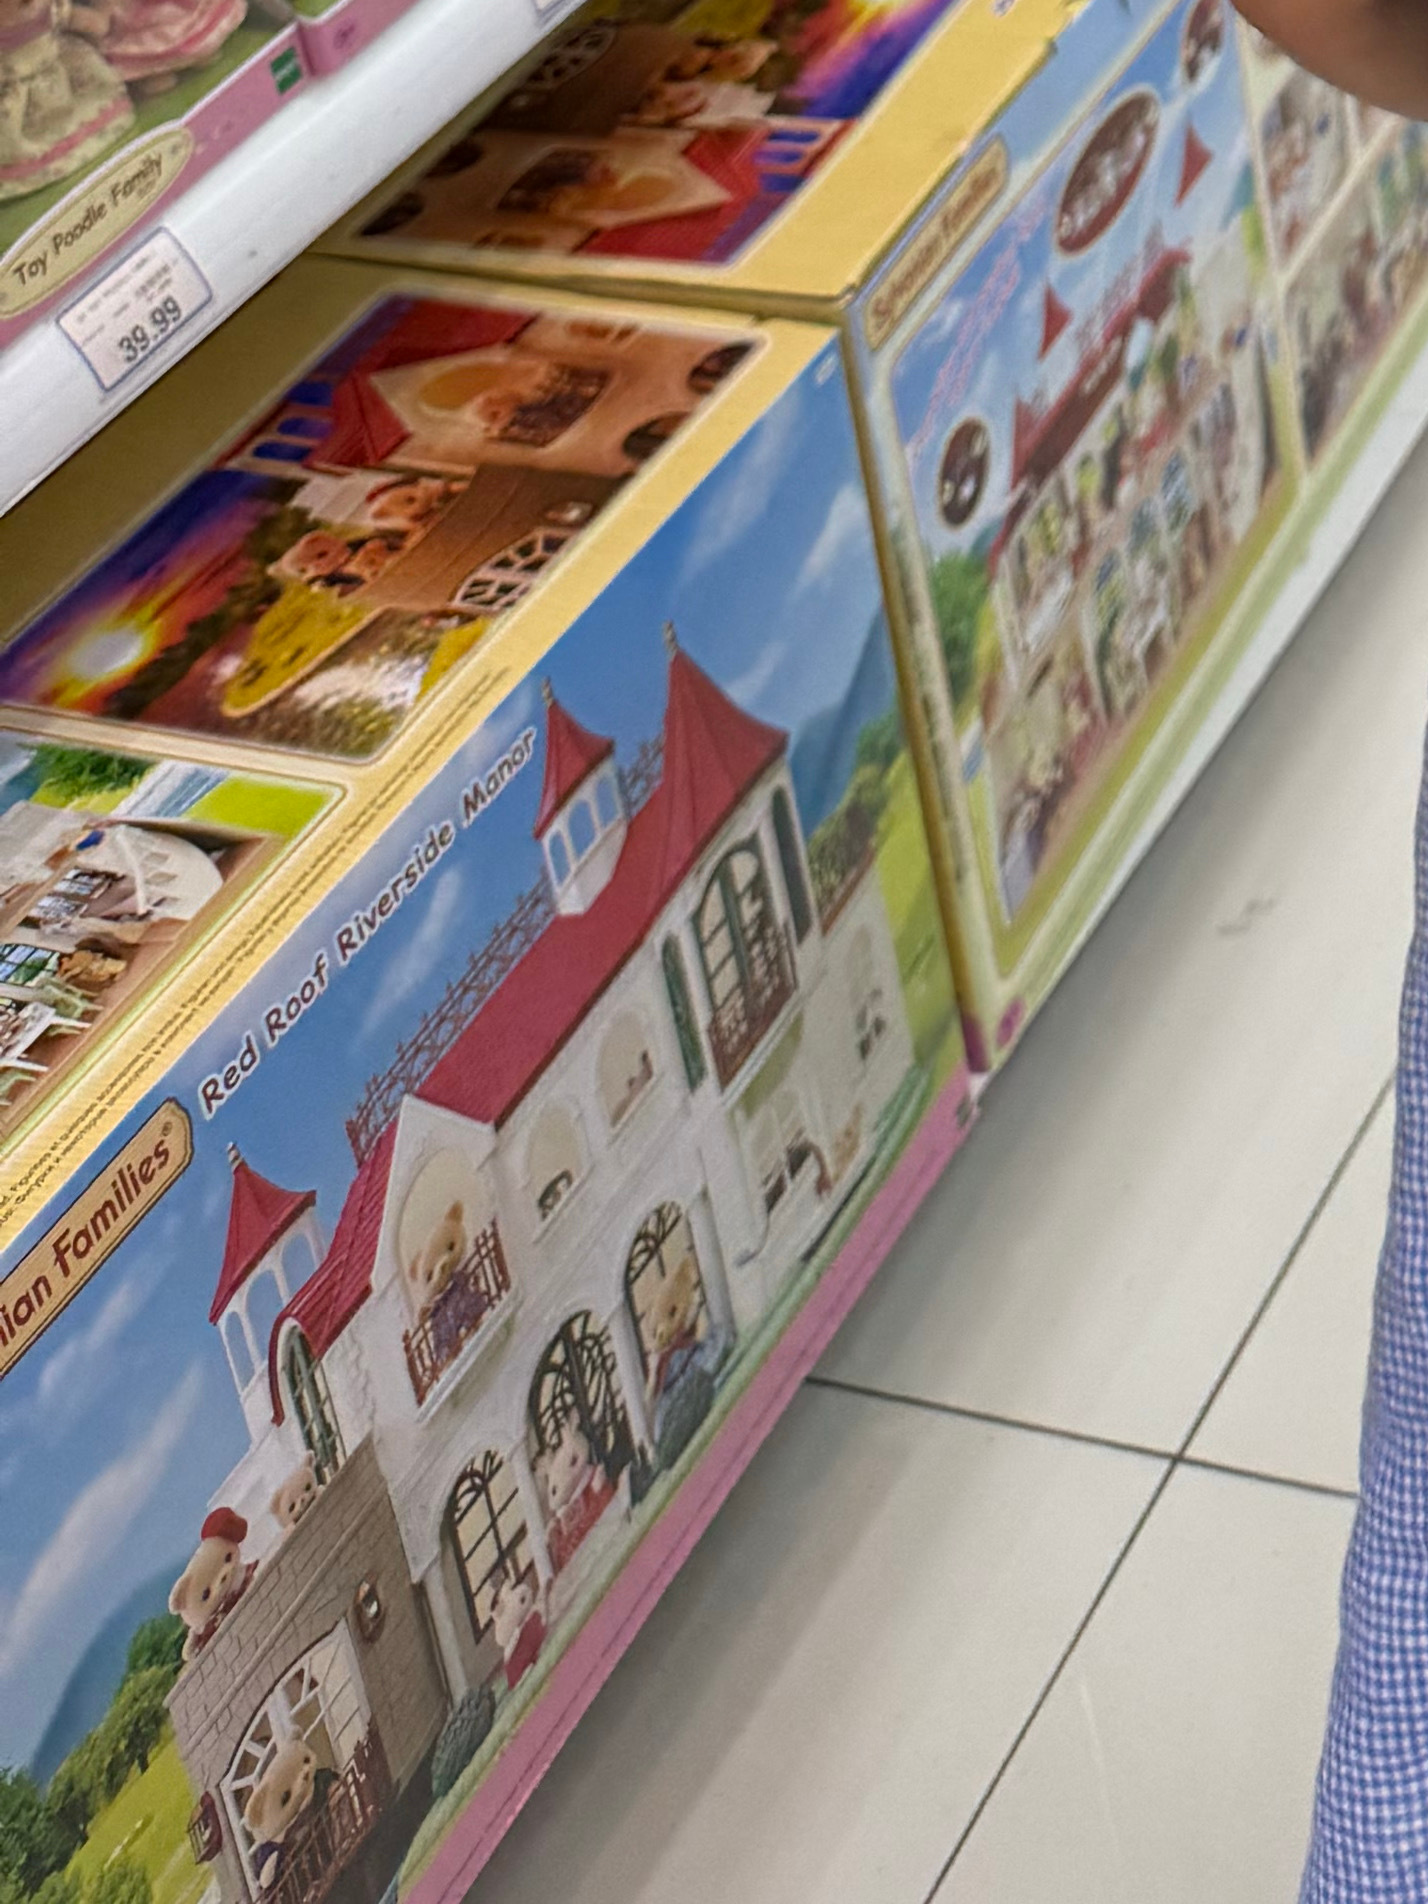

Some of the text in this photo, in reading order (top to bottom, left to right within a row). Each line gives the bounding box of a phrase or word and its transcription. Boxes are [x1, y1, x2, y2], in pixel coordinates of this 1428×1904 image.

[13, 151, 163, 285] Toy Poodle Family
[117, 294, 183, 363] 39.99
[201, 1034, 258, 1114] Red
[265, 952, 326, 1042] Roof
[336, 823, 452, 962] Riverside
[462, 729, 534, 822] Manor
[52, 1139, 170, 1278] Families
